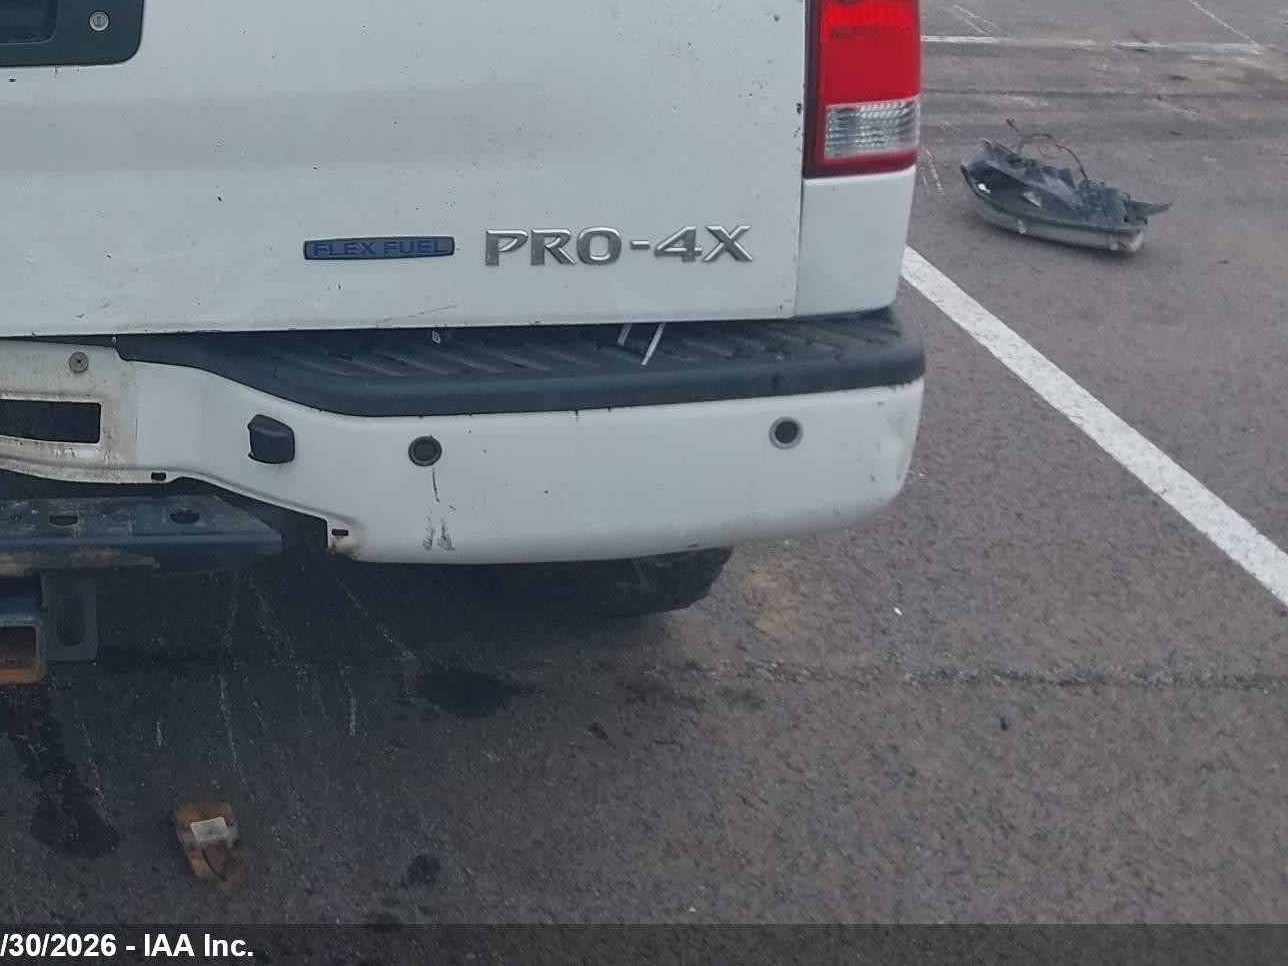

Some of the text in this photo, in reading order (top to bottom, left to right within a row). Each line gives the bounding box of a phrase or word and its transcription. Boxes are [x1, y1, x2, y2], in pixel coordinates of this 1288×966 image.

[312, 238, 449, 258] FLEX FUEL
[484, 225, 753, 267] PRO-4X
